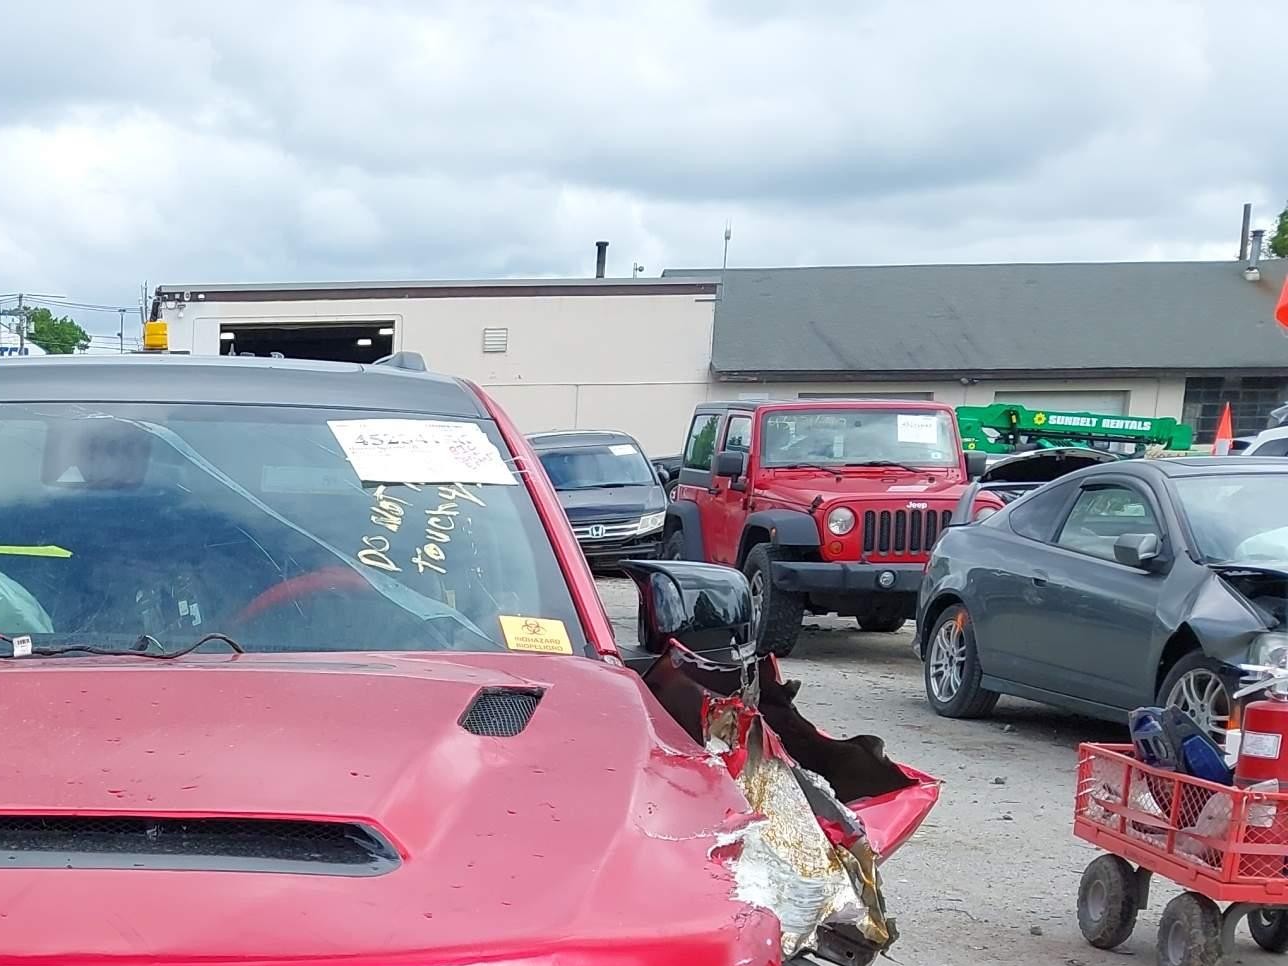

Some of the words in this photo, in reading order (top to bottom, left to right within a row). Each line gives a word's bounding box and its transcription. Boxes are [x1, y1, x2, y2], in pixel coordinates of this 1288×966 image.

[1048, 414, 1097, 428] SUNBELT
[1101, 418, 1152, 431] RENTALS
[906, 501, 928, 510] Jeep
